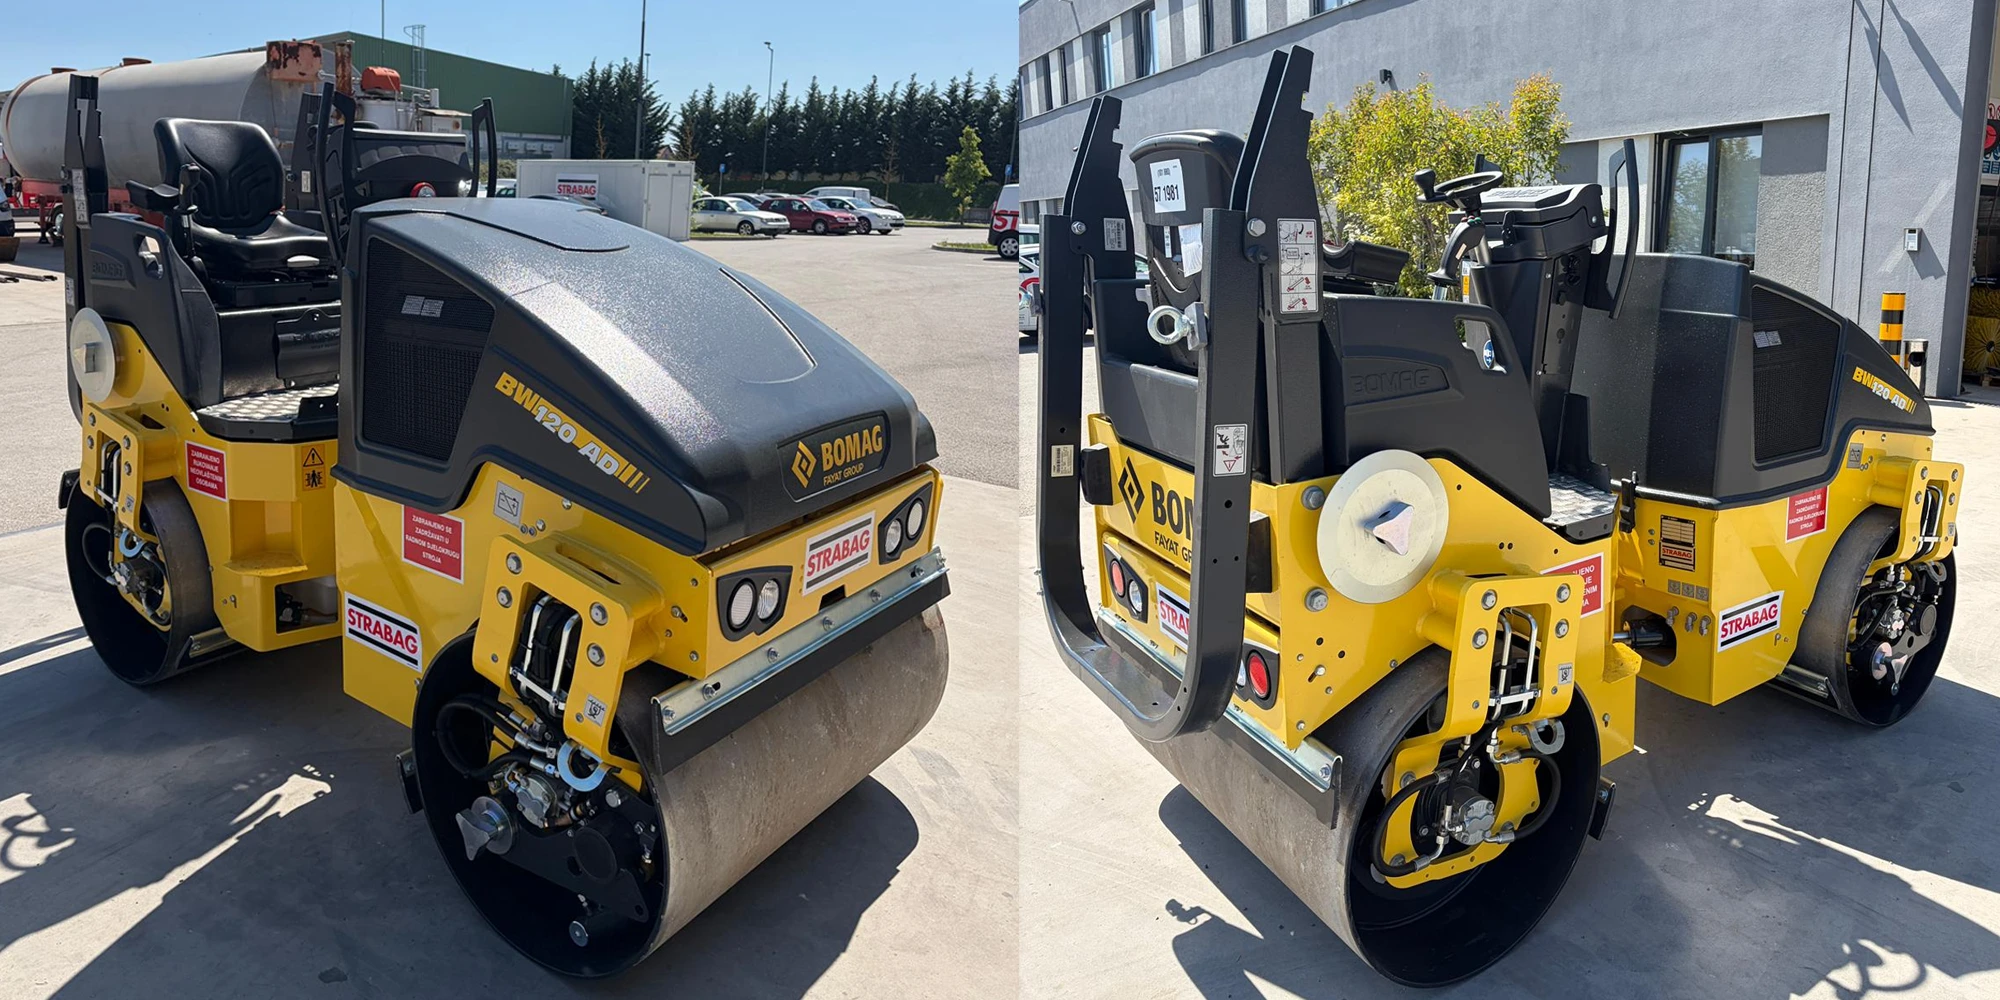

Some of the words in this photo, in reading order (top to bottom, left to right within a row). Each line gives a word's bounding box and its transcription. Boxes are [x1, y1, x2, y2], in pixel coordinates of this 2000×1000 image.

[557, 184, 597, 196] STRABAG
[1163, 184, 1179, 201] 1981
[821, 424, 883, 472] BOMAG
[823, 470, 843, 487] FAYAT
[843, 462, 865, 479] GROUP
[412, 514, 445, 532] ZABRANJENO
[445, 525, 453, 535] SE
[414, 526, 445, 543] ZADRŽAVATI
[444, 537, 450, 545] U
[405, 534, 427, 548] RADNOM
[426, 541, 460, 560] DJELOKRUGU
[806, 529, 871, 578] STRABAG
[1154, 530, 1179, 557] FAYAT
[1662, 547, 1693, 559] STRABAG
[422, 551, 442, 565] STROJA
[348, 607, 418, 655] STRABAG
[1720, 603, 1779, 639] STRABAG
